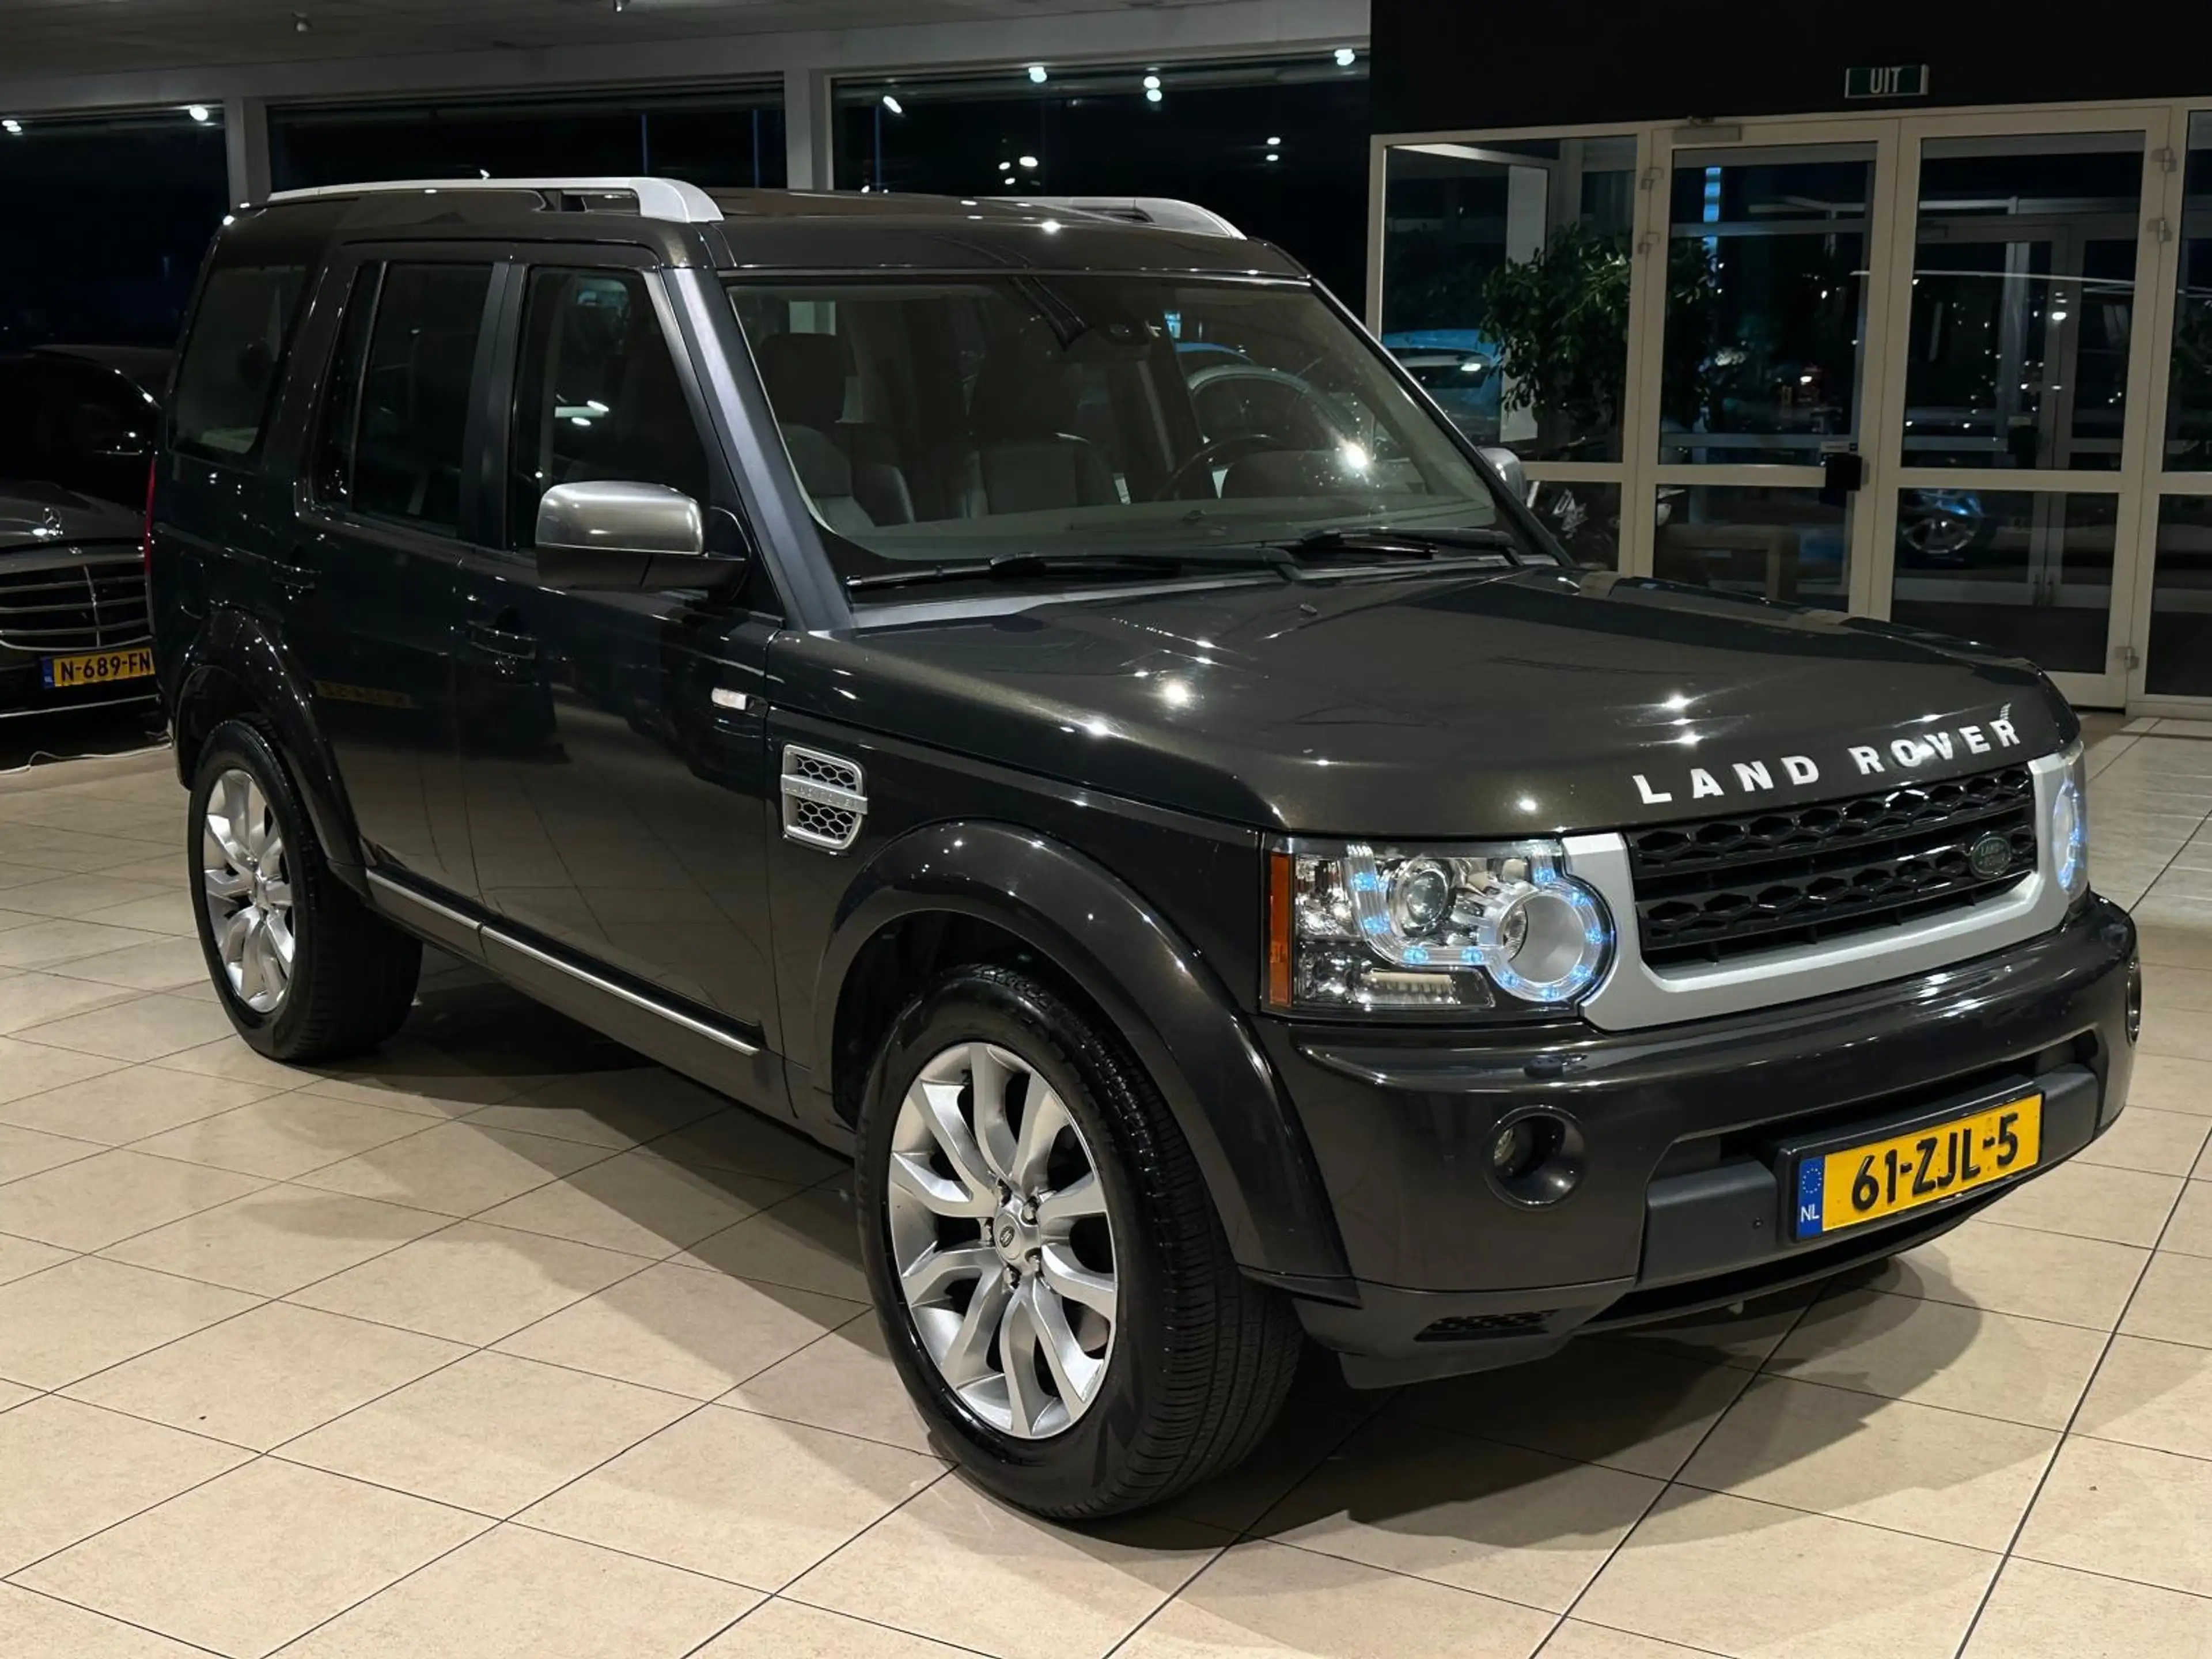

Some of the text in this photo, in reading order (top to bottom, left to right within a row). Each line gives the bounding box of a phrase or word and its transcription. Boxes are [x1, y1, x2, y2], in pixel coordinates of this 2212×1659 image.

[1870, 67, 1902, 93] UIT
[61, 652, 150, 681] N-689-FN
[1633, 720, 2020, 804] LAND ROVER
[1851, 1112, 2019, 1211] 61-ZJL-5
[1801, 1203, 1820, 1222] NL
